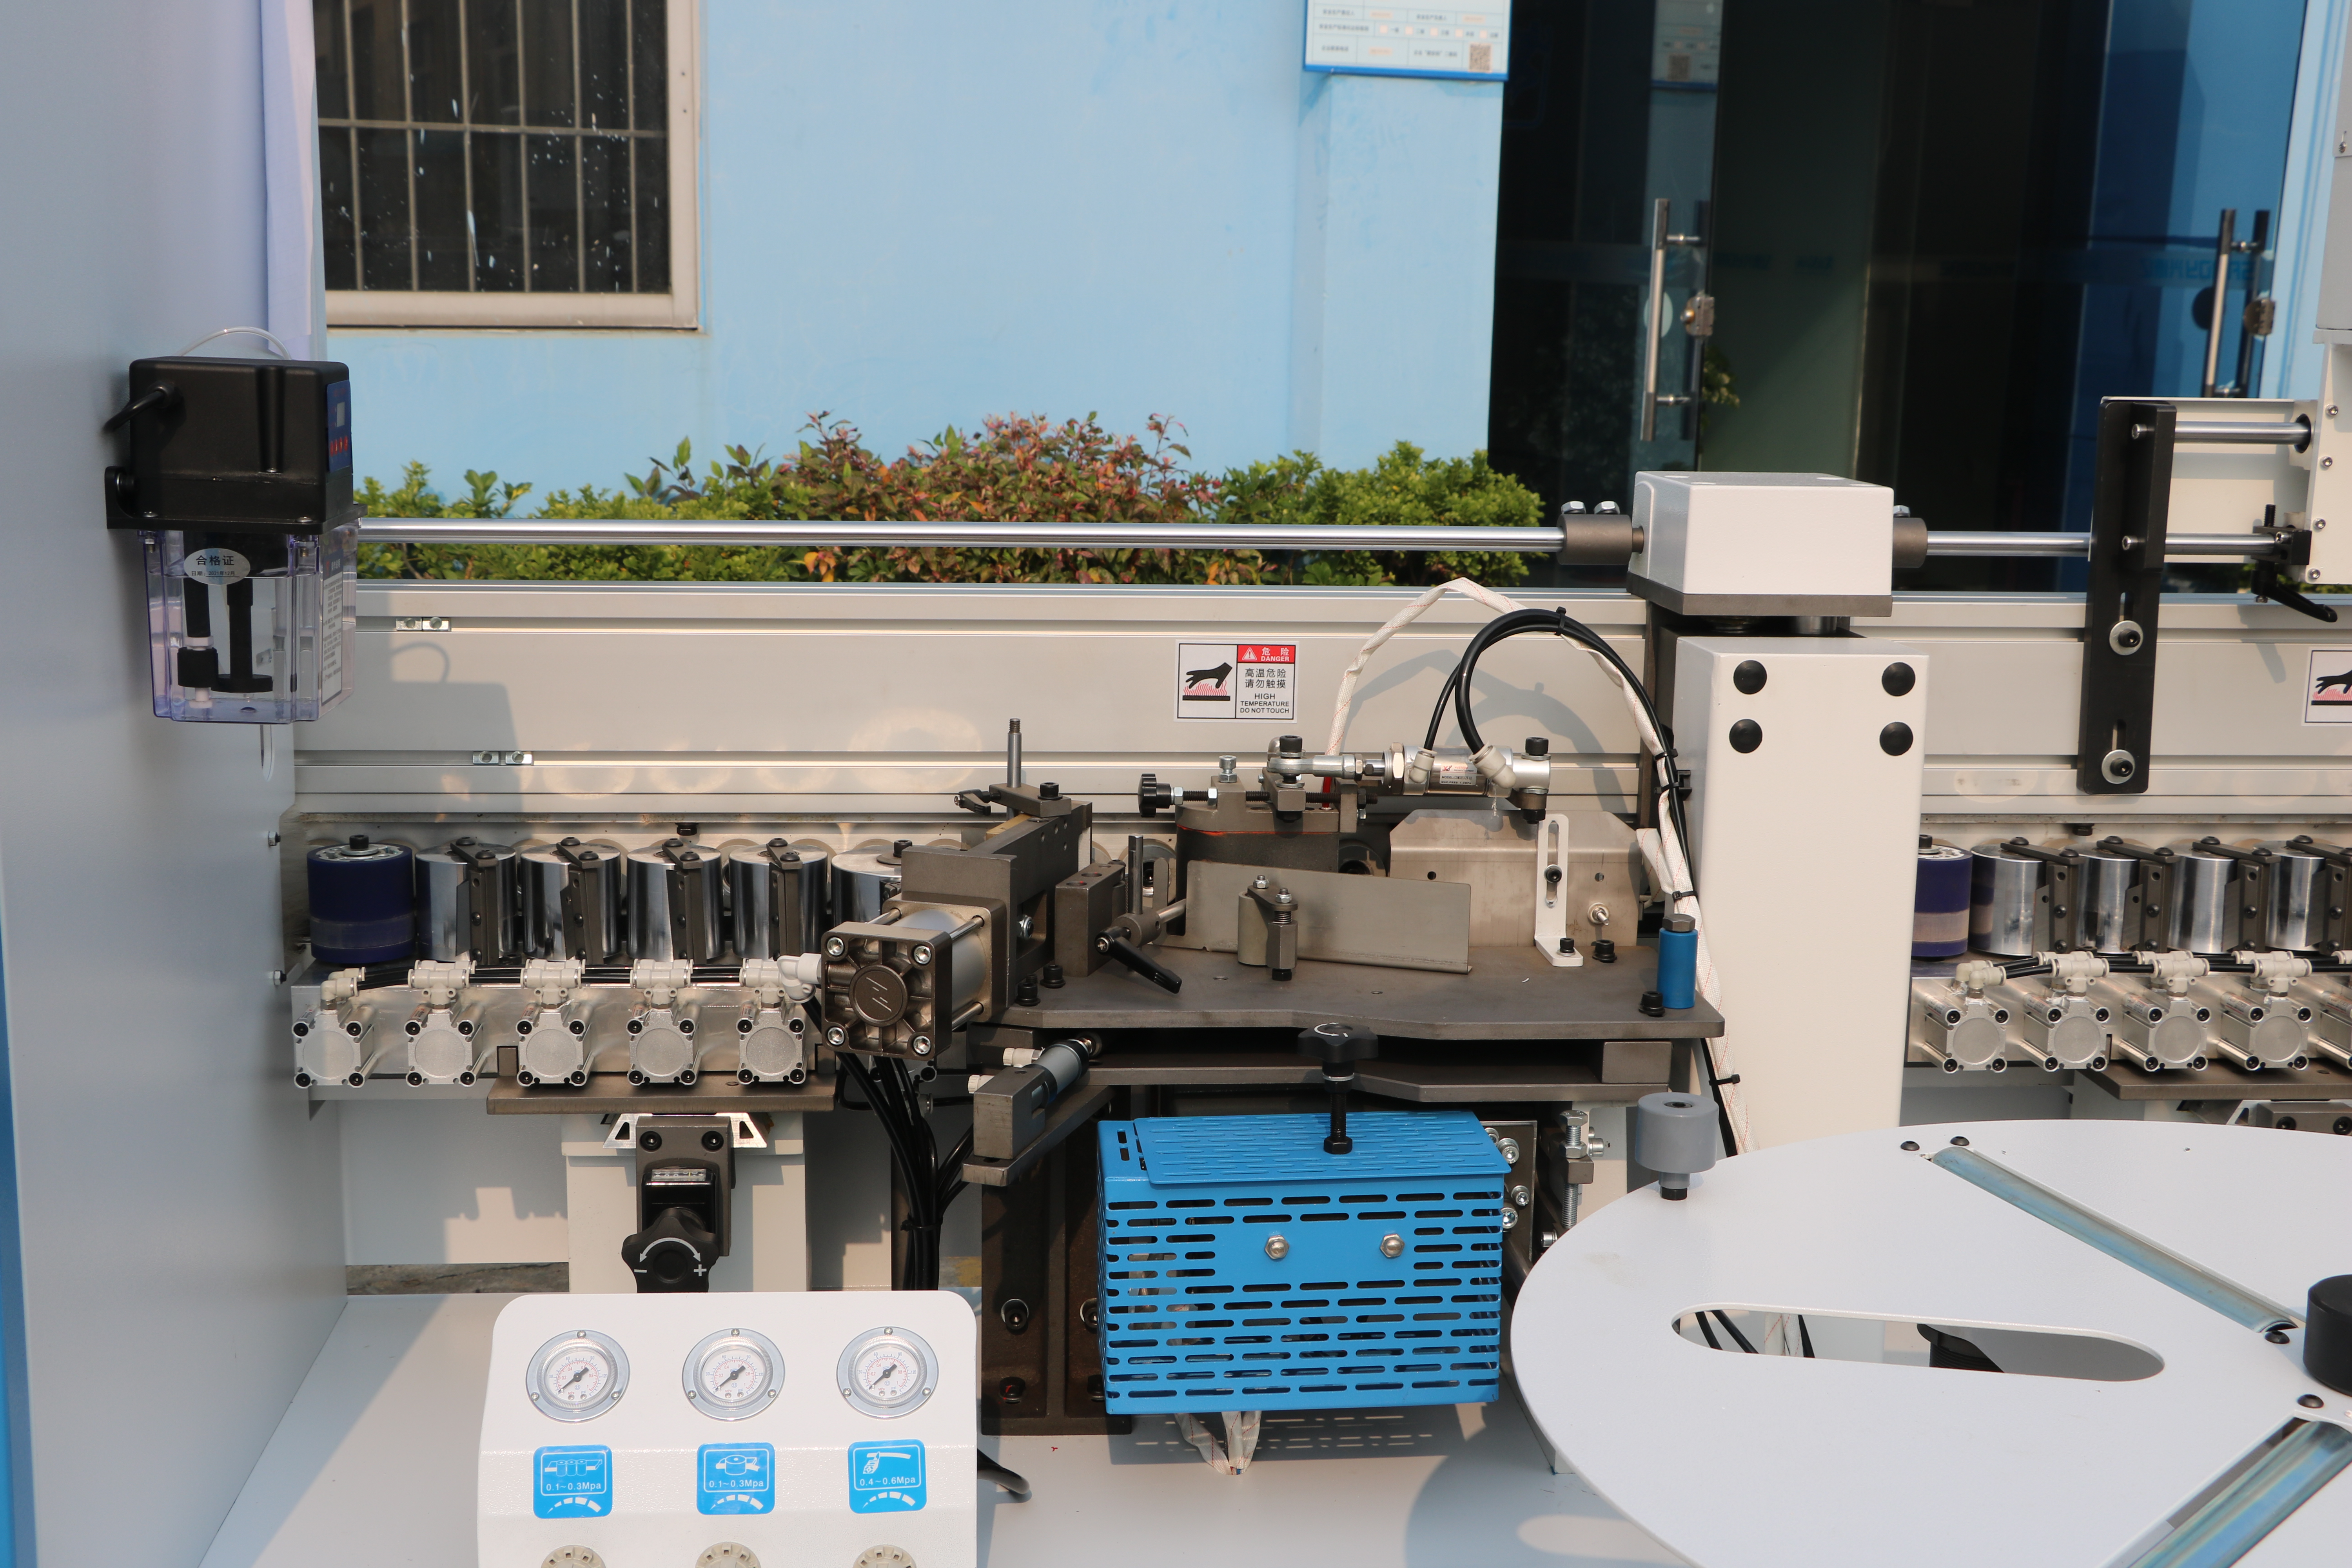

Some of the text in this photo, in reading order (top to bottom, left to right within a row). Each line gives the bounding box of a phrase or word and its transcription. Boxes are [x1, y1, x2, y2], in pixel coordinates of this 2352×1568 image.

[196, 555, 234, 566] 合格证
[1261, 647, 1289, 656] 危险
[1245, 668, 1286, 678] 高温危险
[1245, 679, 1286, 689] 请勿触摸
[709, 1479, 764, 1488] 0.1~0.3Mpa
[860, 1476, 915, 1486] 0.4~0.6Mpa
[546, 1482, 601, 1491] 0.1~0.3Mpa
